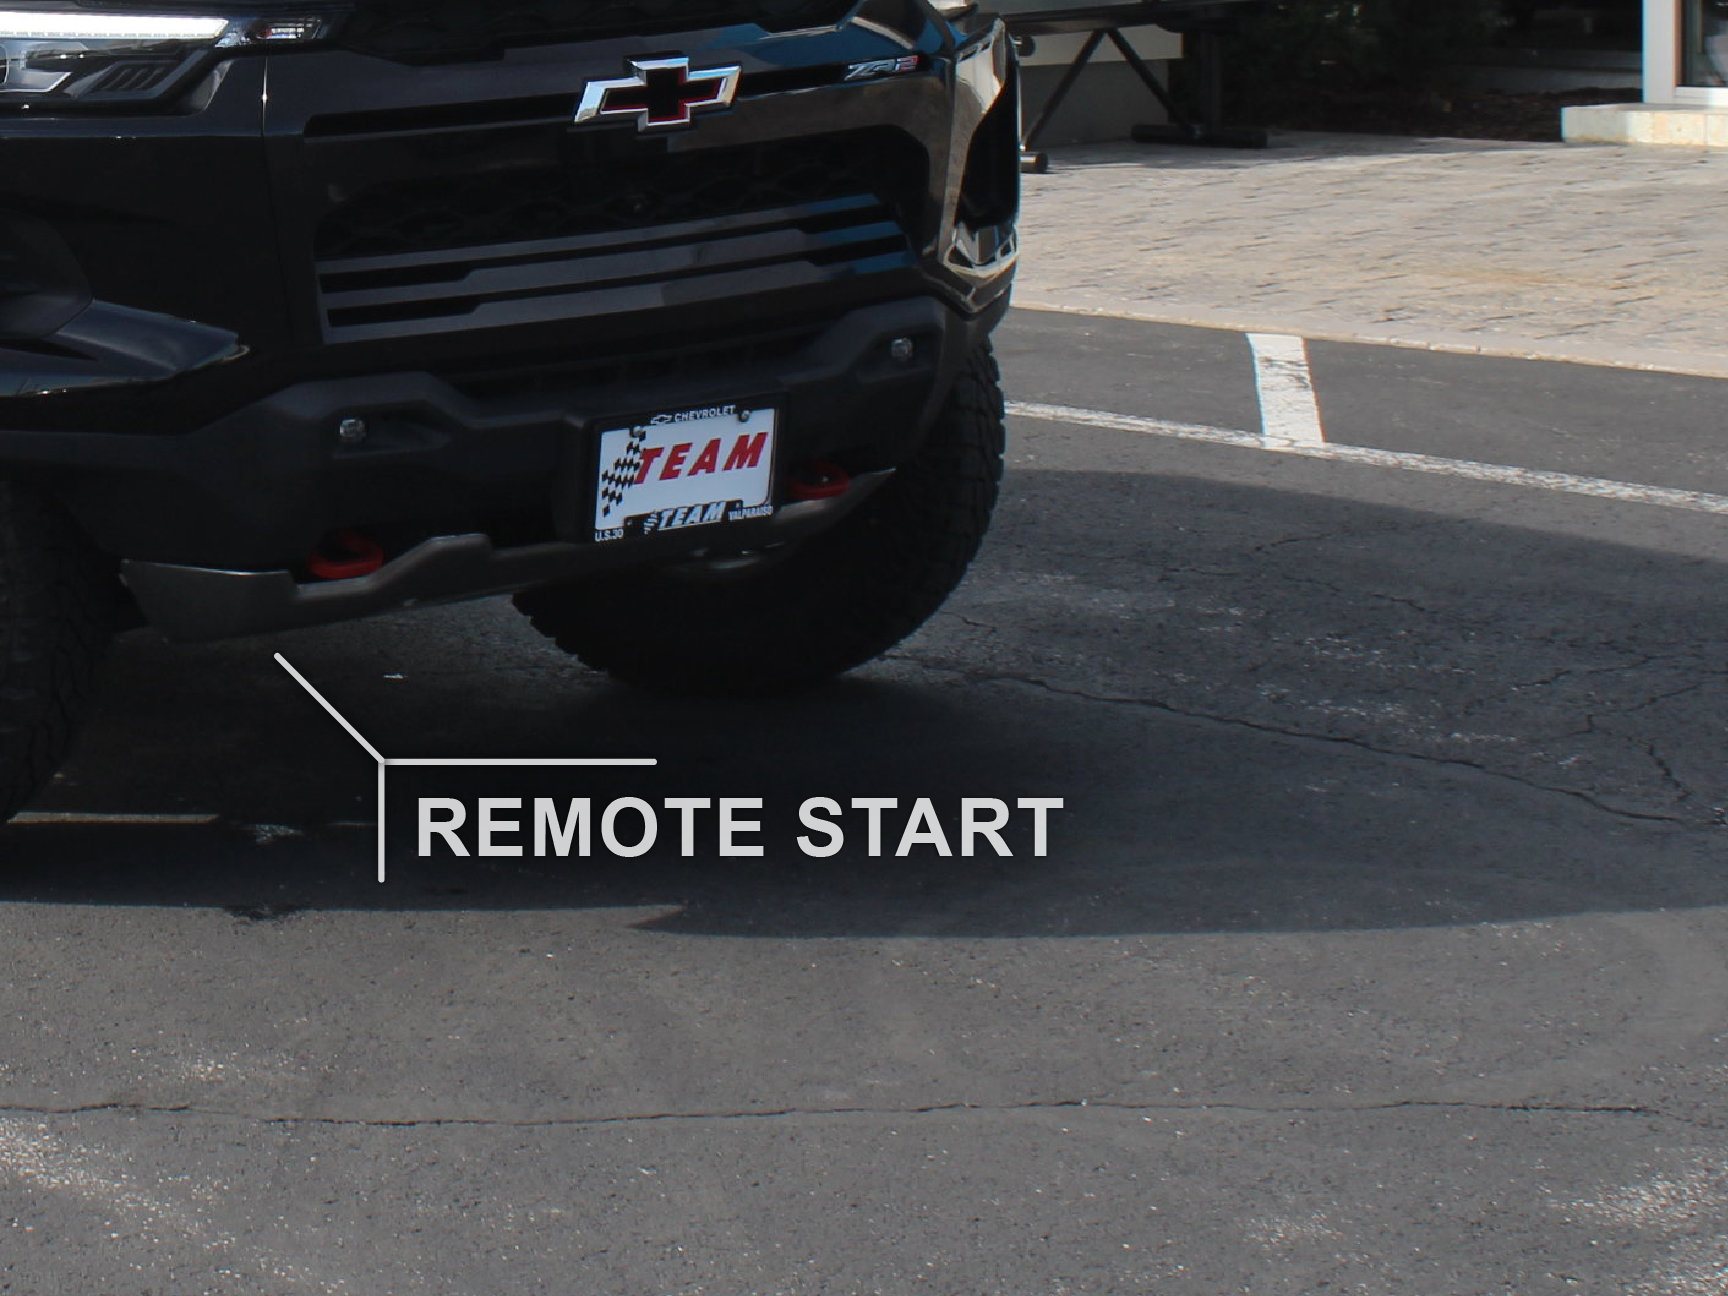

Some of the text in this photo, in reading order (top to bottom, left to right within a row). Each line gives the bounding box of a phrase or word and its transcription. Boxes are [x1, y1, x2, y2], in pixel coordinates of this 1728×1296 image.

[674, 404, 737, 423] CHEVROLET
[633, 432, 768, 484] TEAM
[658, 502, 727, 531] TEAM
